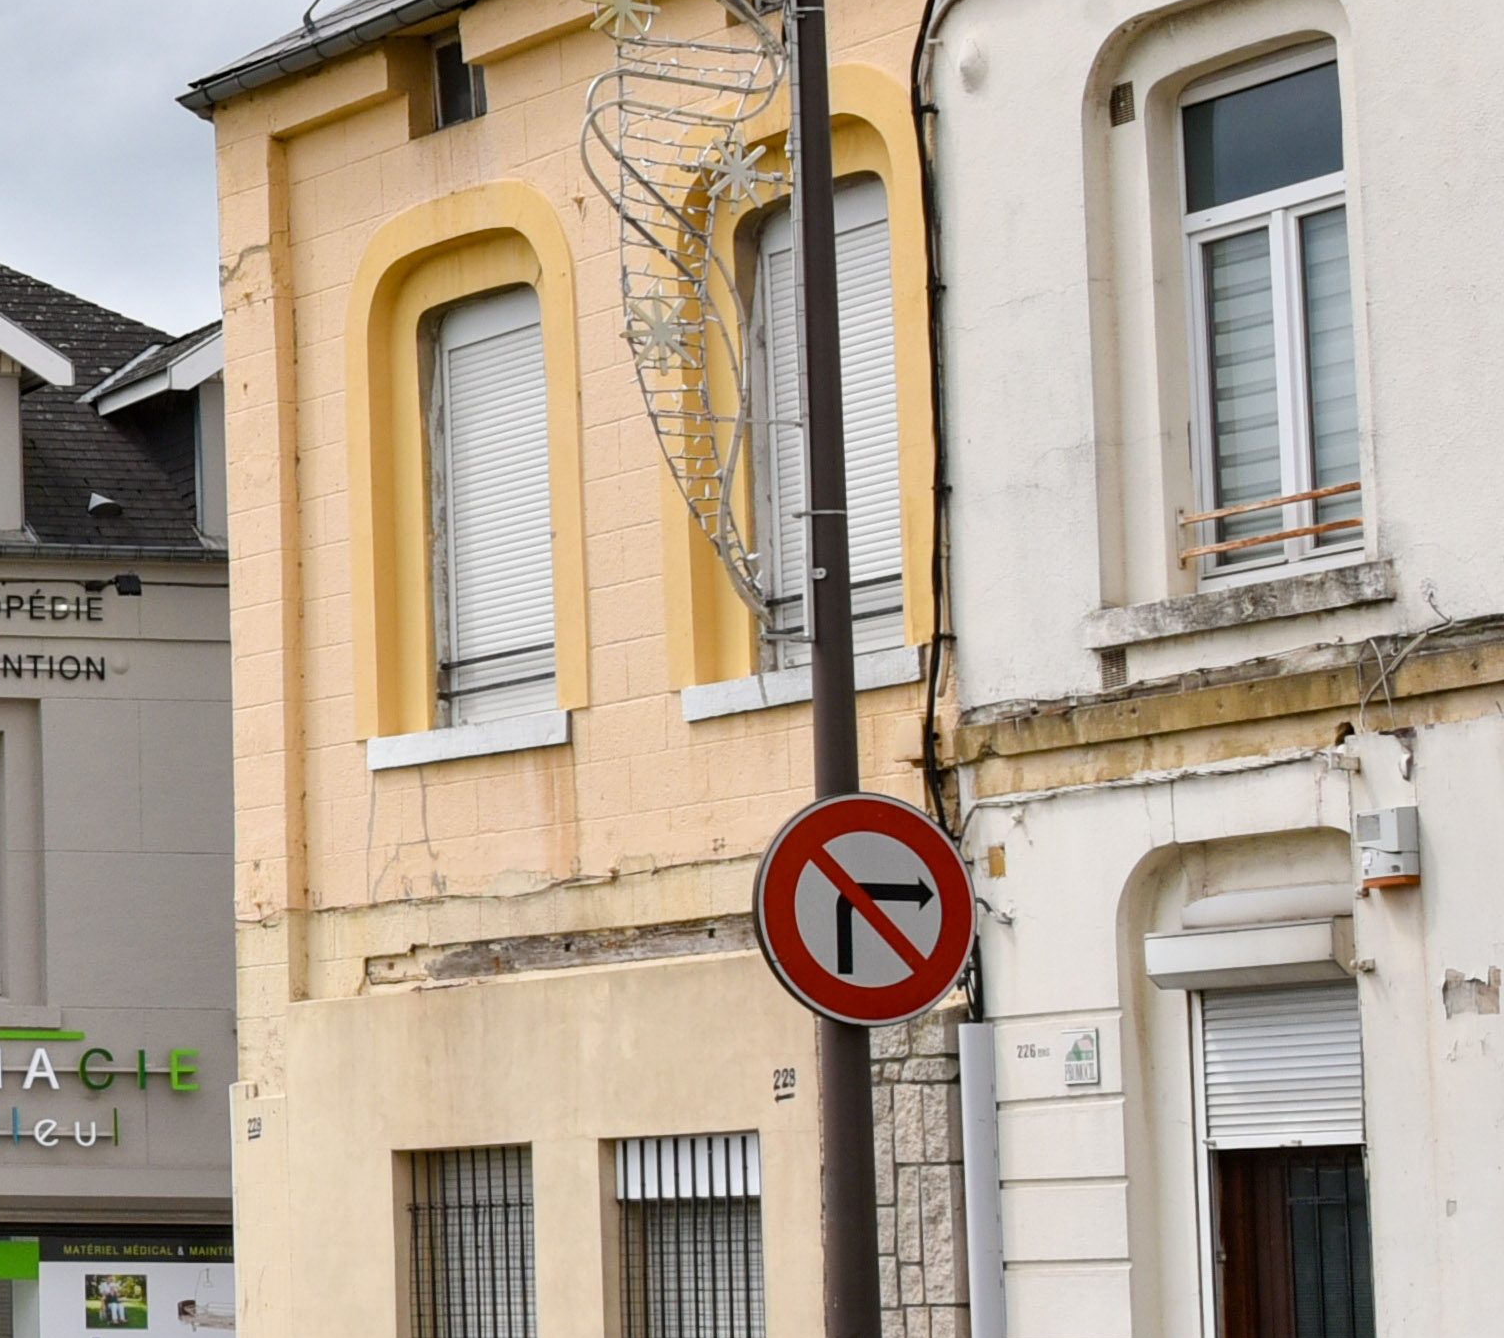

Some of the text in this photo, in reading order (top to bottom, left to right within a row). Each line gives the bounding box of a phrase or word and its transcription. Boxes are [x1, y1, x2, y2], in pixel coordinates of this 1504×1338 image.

[1016, 1043, 1036, 1059] 226
[773, 1067, 795, 1091] 228
[63, 1243, 119, 1256] MATÉRIEL
[123, 1243, 173, 1257] MÉDICAL
[177, 1245, 185, 1256] &
